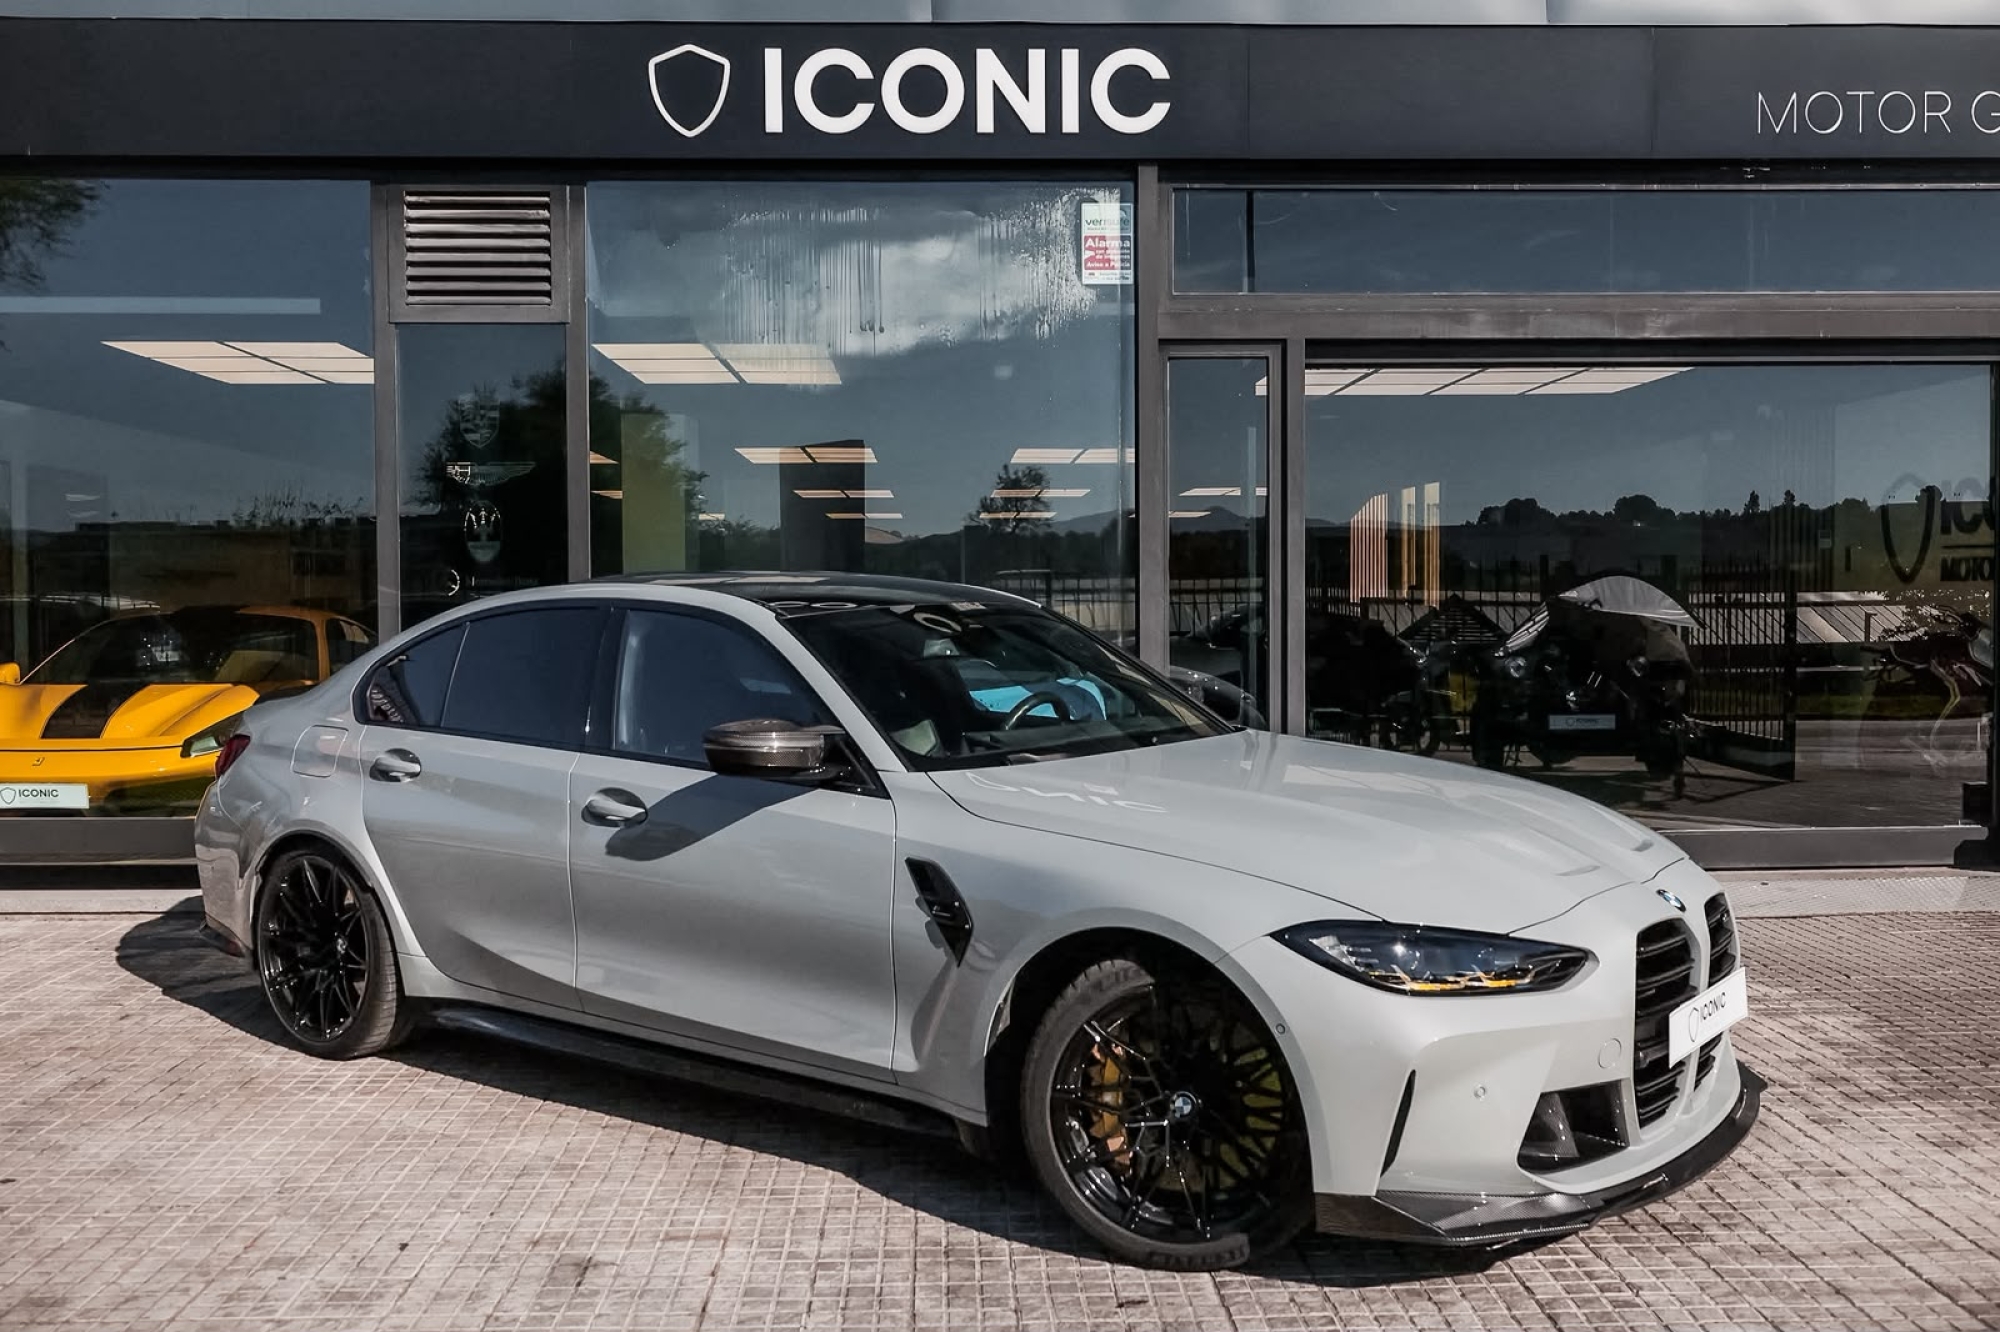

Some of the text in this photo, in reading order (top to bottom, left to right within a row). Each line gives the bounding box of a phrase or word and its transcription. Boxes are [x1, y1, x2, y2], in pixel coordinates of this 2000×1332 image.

[764, 47, 1171, 134] ICONIC
[1757, 90, 1951, 134] MOTOR
[18, 788, 60, 798] ICONIC
[1700, 991, 1726, 1023] ICONIC
